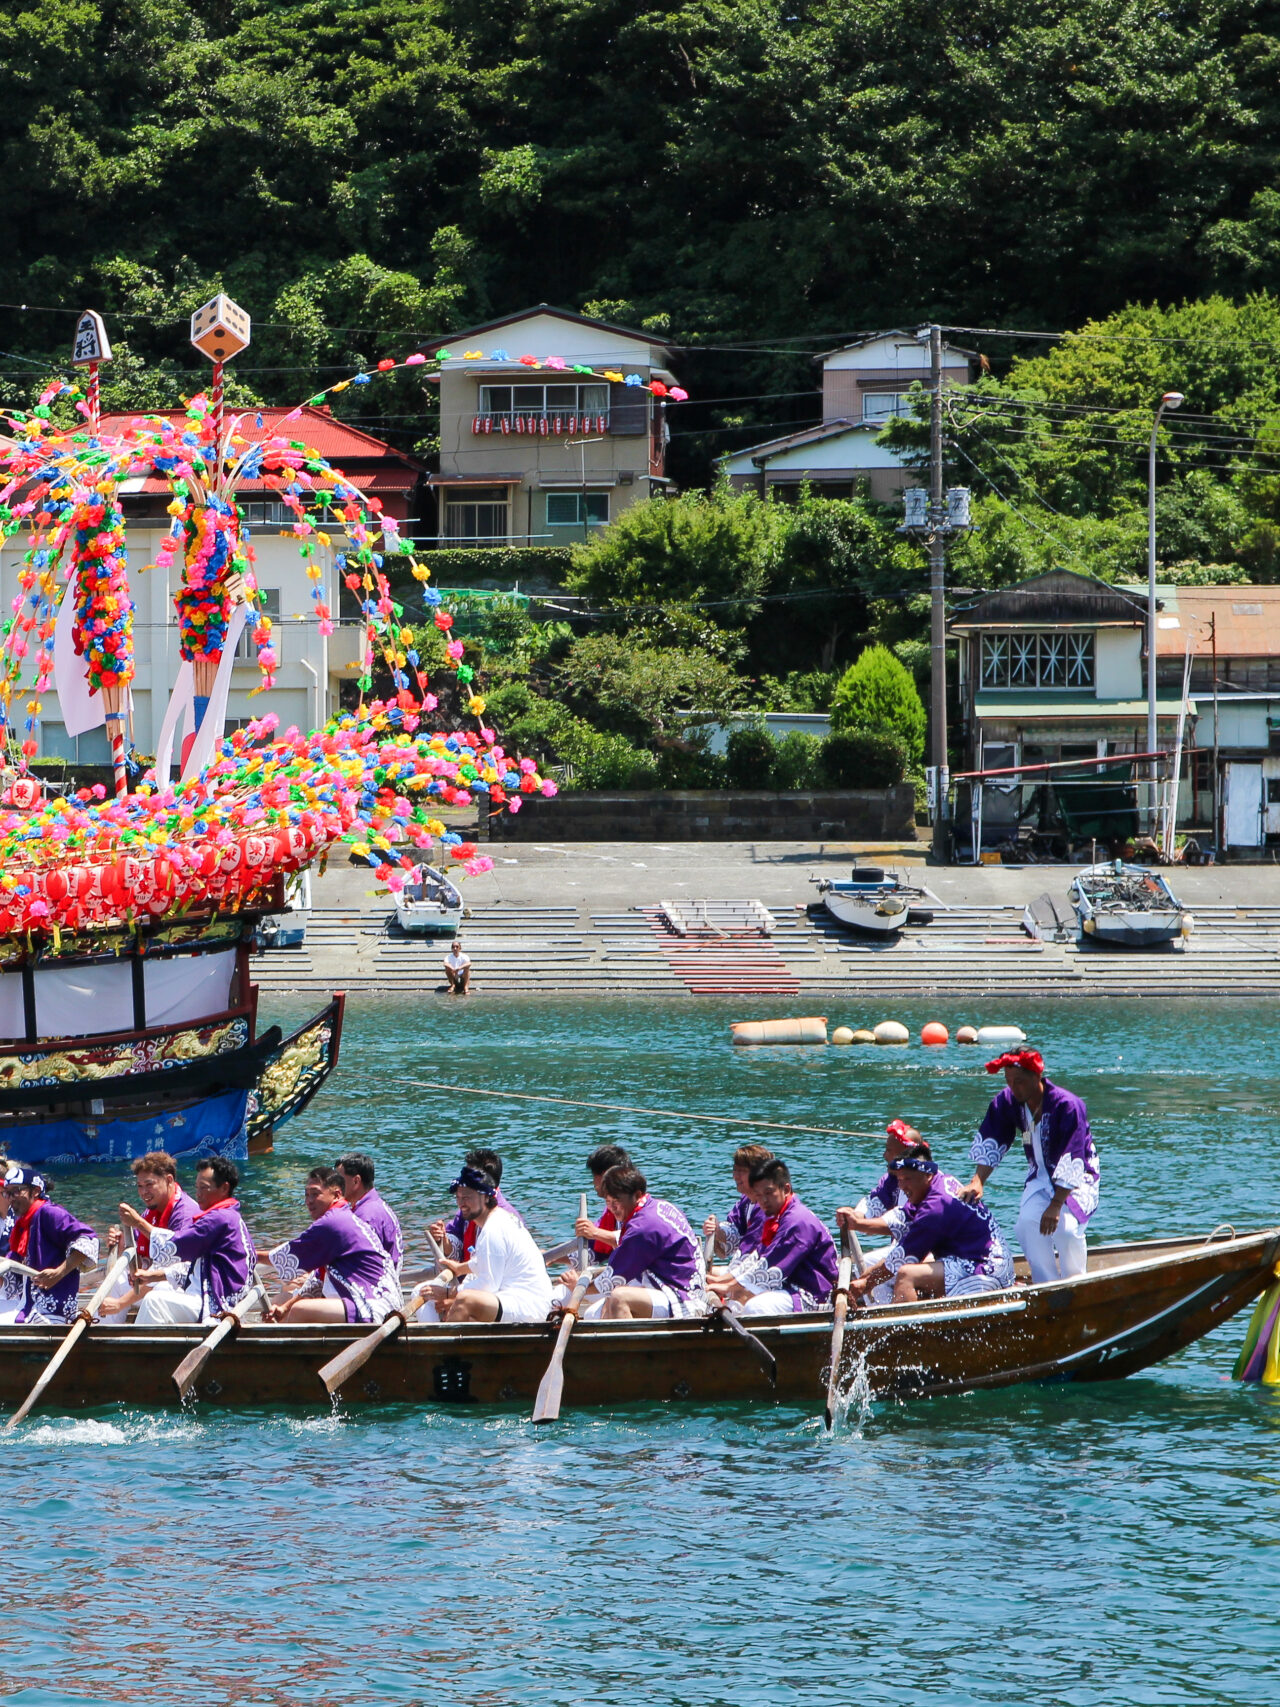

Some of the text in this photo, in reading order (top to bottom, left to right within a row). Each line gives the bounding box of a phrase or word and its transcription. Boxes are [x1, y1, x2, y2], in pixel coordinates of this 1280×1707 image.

[15, 783, 30, 799] 東
[293, 833, 304, 848] 東
[129, 864, 139, 879] 東
